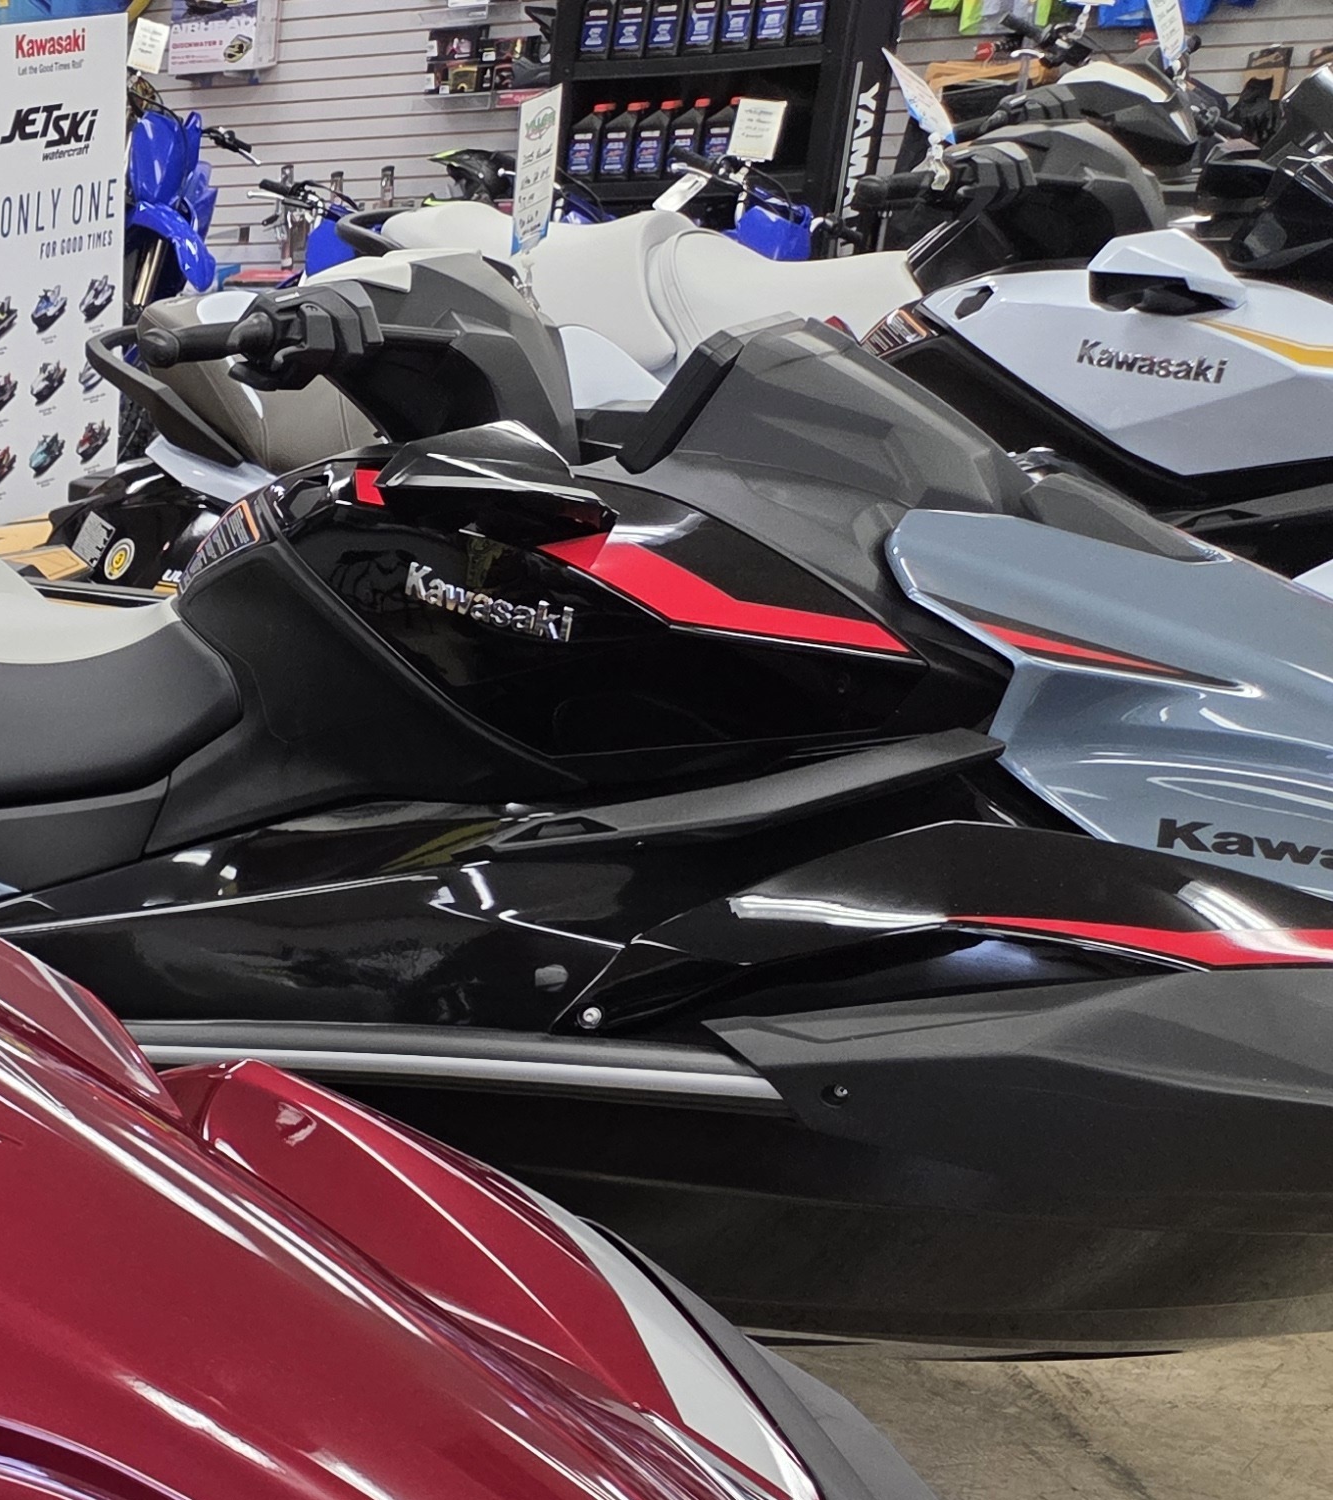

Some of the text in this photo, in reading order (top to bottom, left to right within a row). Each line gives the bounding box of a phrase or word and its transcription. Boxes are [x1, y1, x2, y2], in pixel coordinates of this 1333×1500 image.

[15, 27, 85, 59] Kawasaki
[29, 64, 38, 75] the
[39, 62, 54, 74] Good
[54, 60, 71, 72] Times
[41, 144, 90, 162] watercraft
[0, 187, 61, 239] ONLY
[72, 178, 117, 226] ONE
[39, 230, 113, 260] FOR GOOD TIMES
[1076, 338, 1229, 385] Kawasaki
[405, 561, 575, 643] Kawasaki
